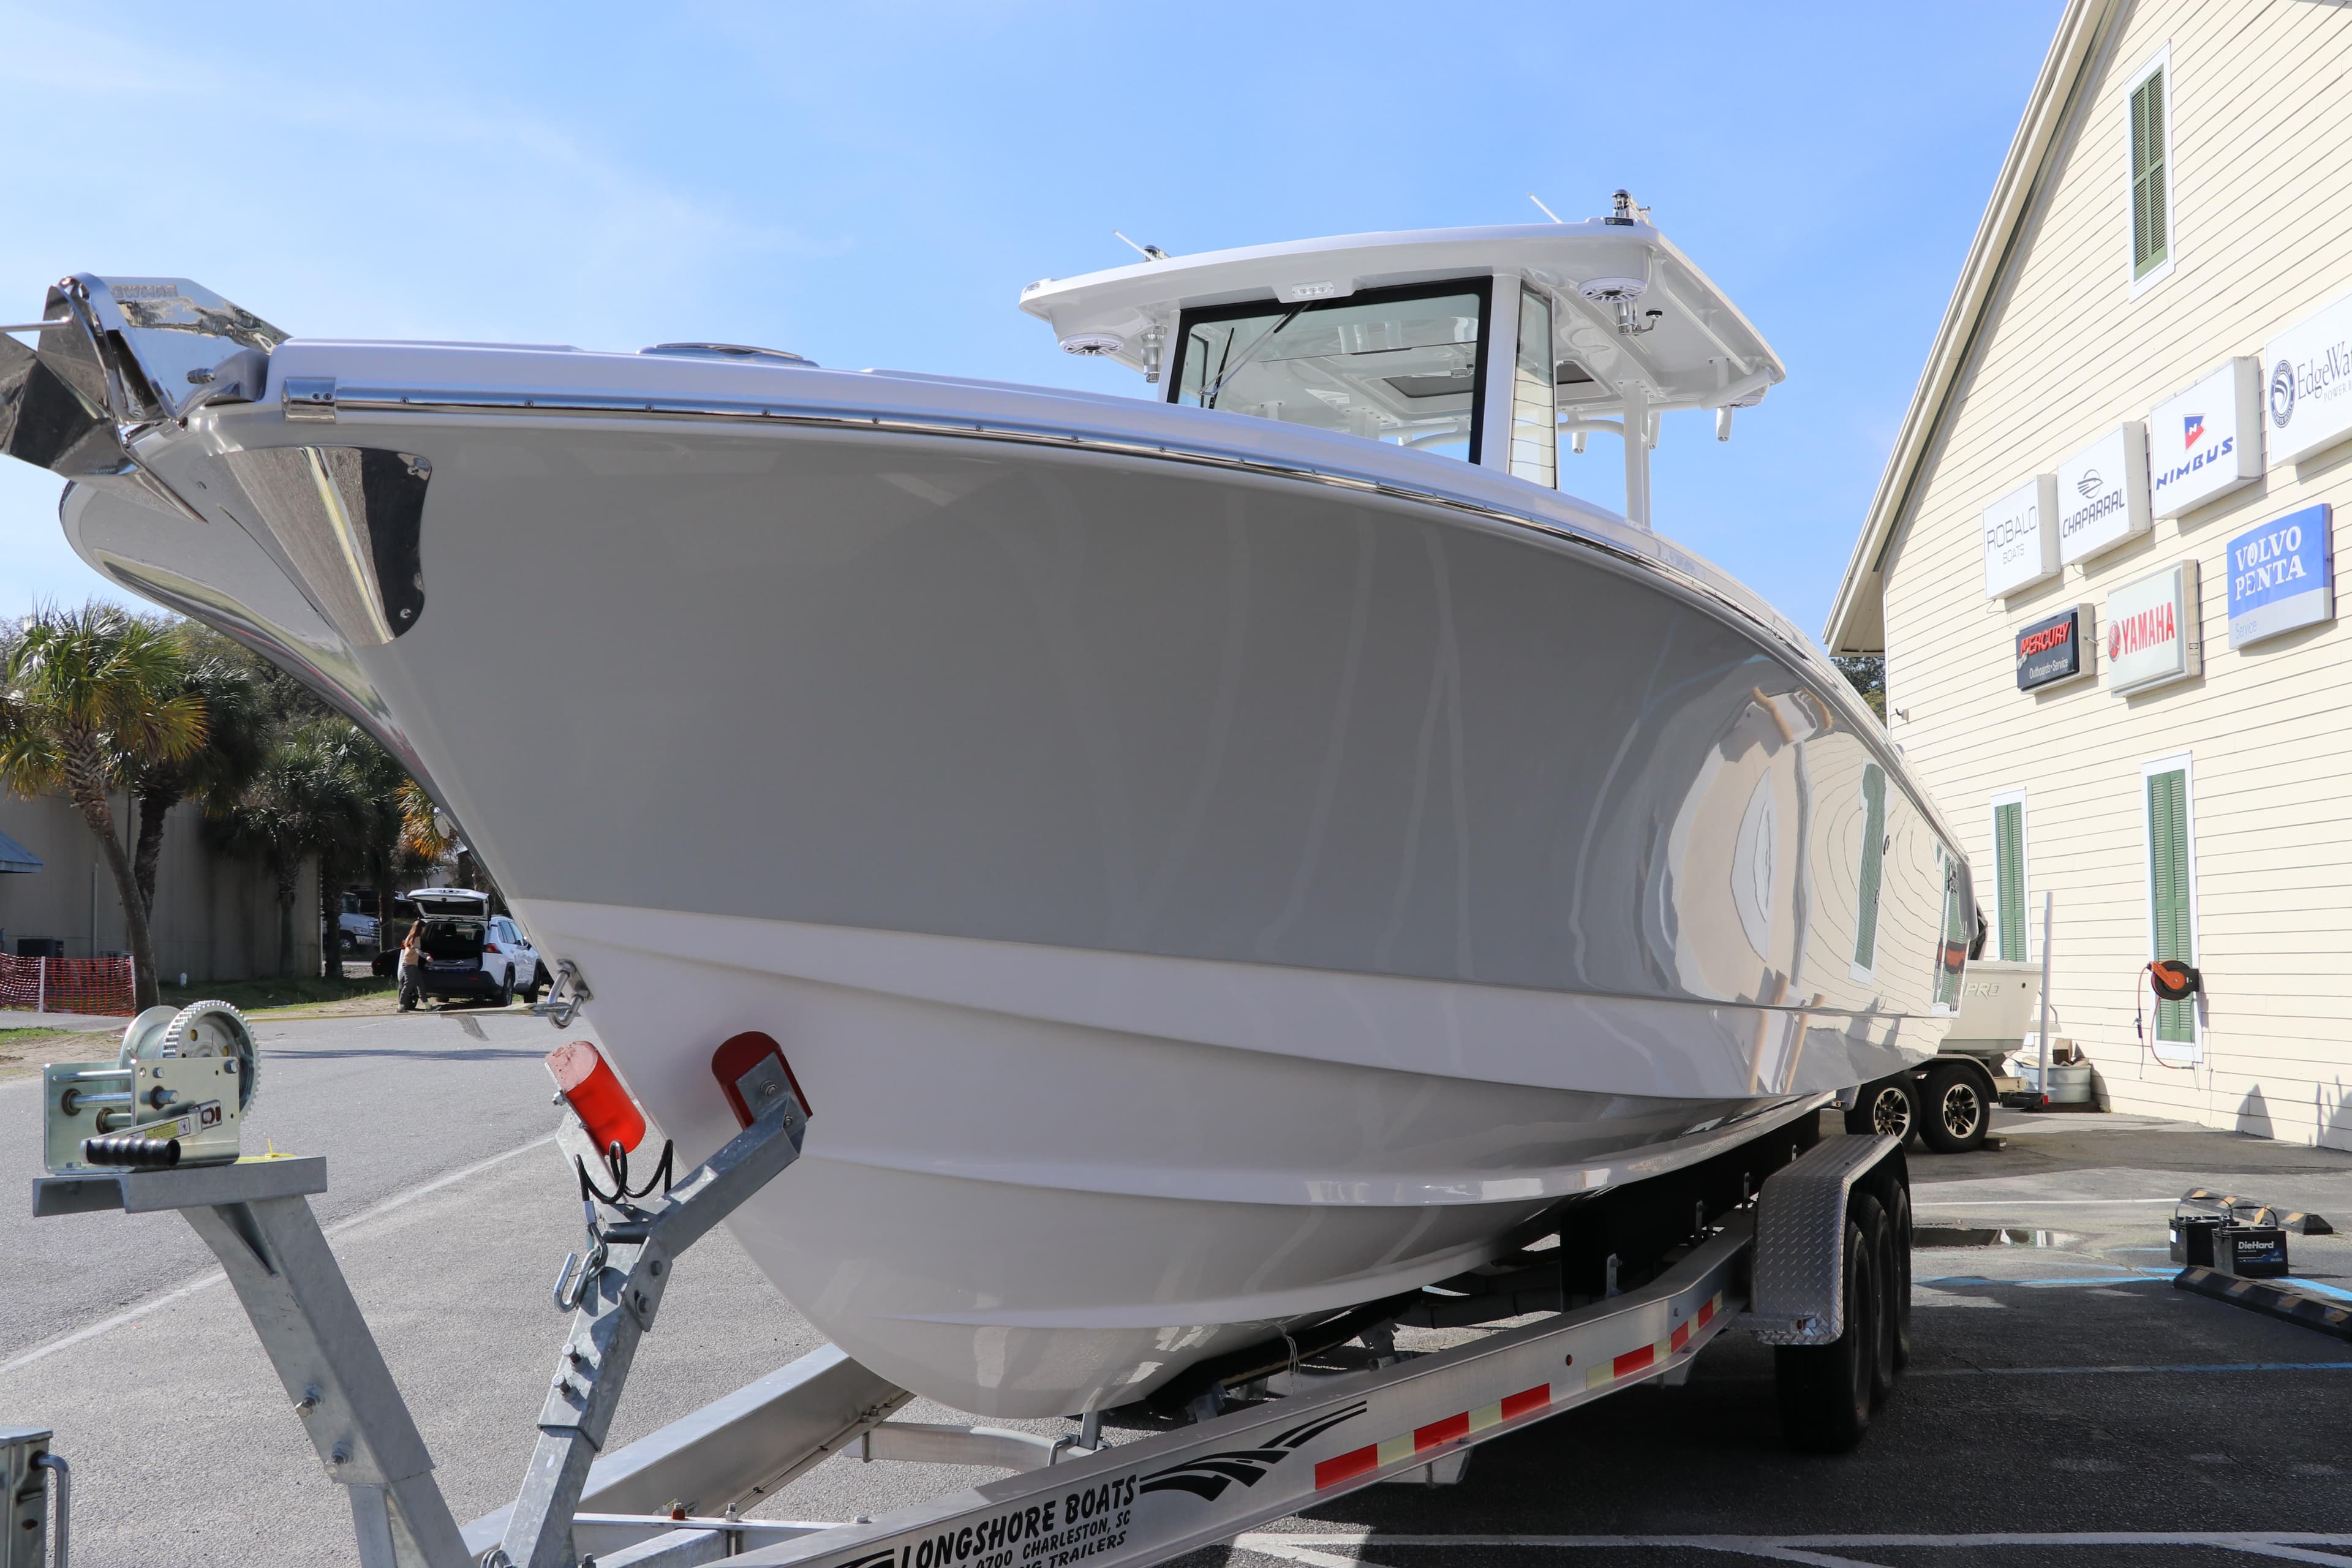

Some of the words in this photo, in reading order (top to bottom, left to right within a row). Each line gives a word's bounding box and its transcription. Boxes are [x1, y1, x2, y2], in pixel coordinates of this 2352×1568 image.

[2296, 341, 2352, 400] EdgeWa
[2323, 383, 2346, 403] POWER
[2156, 436, 2234, 491] NIMBUS
[1986, 505, 2037, 553] ROBALO
[2062, 488, 2125, 539] CHAPARRAL
[2003, 543, 2024, 565] BOATS
[2235, 525, 2302, 571] VOLVO
[2235, 554, 2307, 601] PENTA
[2019, 621, 2071, 659] MERCURY
[2121, 601, 2176, 655] YAMAHA
[2235, 620, 2257, 640] Service
[2237, 1240, 2274, 1250] DieHard
[900, 1501, 1057, 1568] LONGSHORE
[1065, 1474, 1137, 1525] BOATS
[1022, 1517, 1110, 1560] CHARLESTON,
[1115, 1509, 1131, 1529] SC
[1049, 1530, 1127, 1568] TRAILERS
